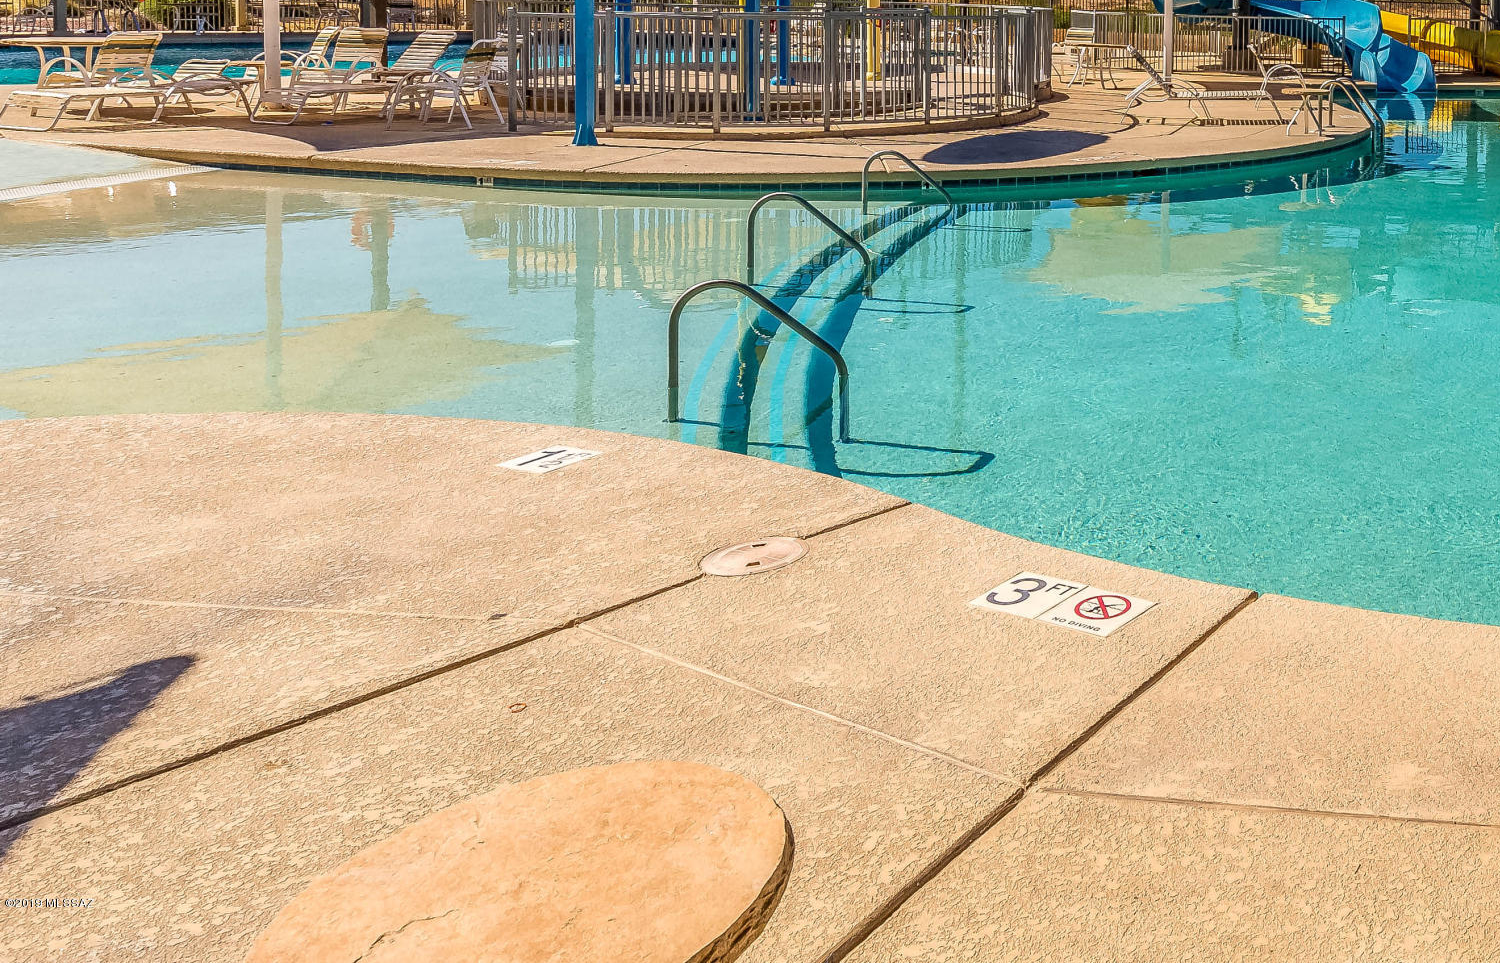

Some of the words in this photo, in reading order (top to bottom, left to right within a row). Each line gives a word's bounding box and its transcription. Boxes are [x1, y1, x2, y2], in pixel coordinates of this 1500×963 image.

[517, 449, 567, 466] 1
[986, 577, 1048, 606] 3
[1045, 583, 1079, 596] FT
[1051, 616, 1067, 624] NO
[1068, 619, 1101, 632] DIVING
